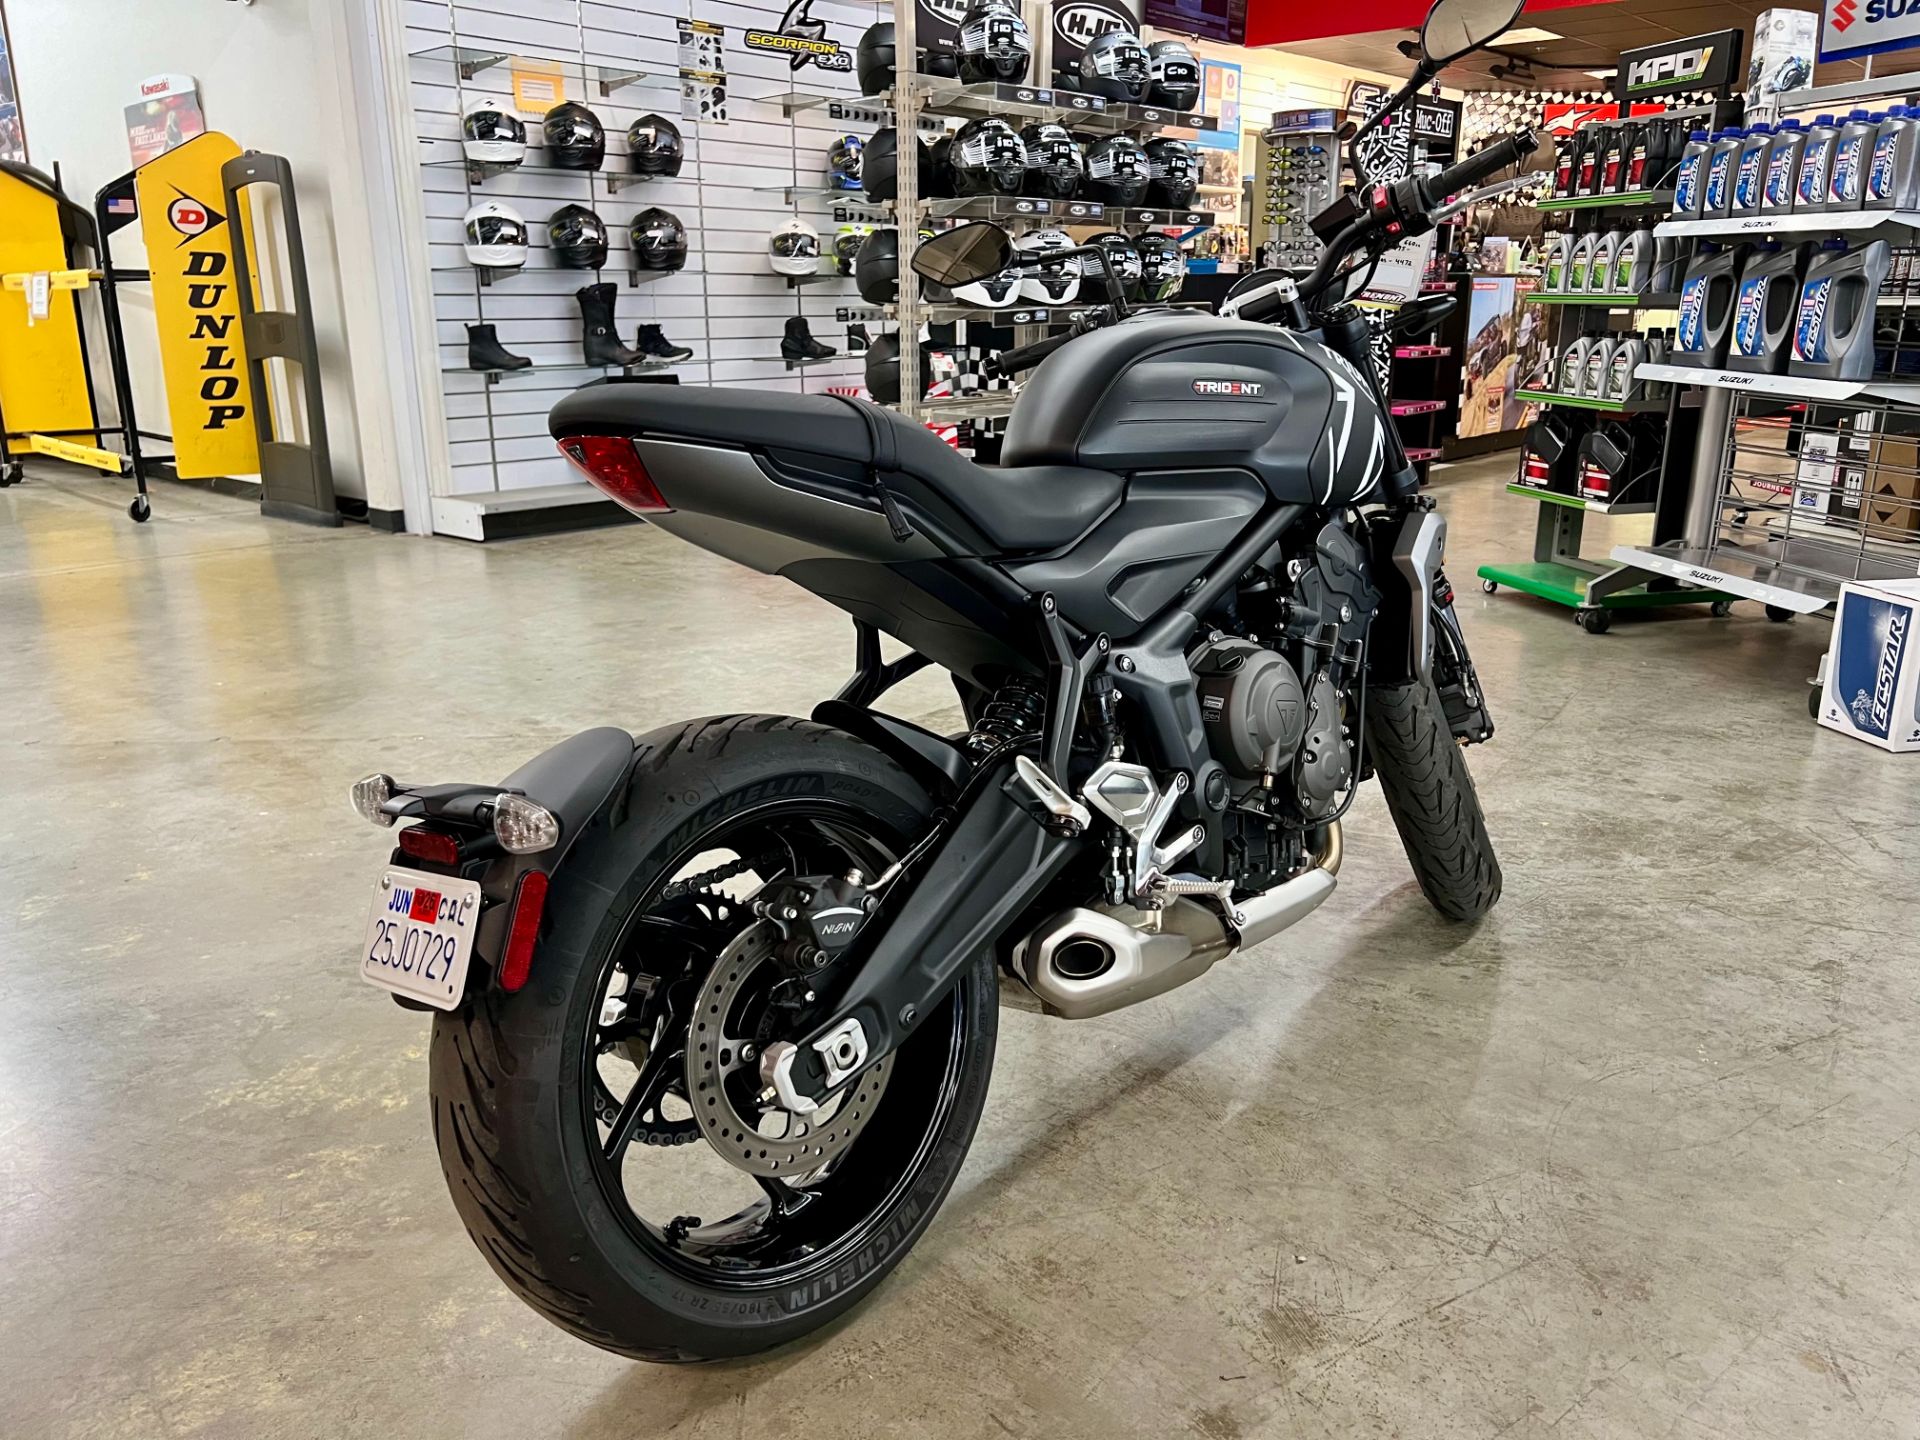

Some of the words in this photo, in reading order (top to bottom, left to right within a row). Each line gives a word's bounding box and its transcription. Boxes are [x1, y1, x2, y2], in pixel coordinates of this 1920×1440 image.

[747, 32, 838, 55] SCORPION
[1415, 110, 1452, 133] Muc-Off
[177, 209, 205, 225] D
[1742, 221, 1778, 229] SUZUKI
[1805, 278, 1832, 360] ECSTAR
[183, 251, 245, 430] DUNLOP
[1196, 381, 1262, 395] TRIDENT
[1718, 375, 1754, 385] SUZUKI
[1752, 480, 1785, 493] JOURNEY
[1689, 570, 1723, 583] SUZUKI
[1871, 610, 1908, 732] ECSTAR
[664, 774, 819, 853] MICHELIN
[389, 888, 413, 914] JUN
[438, 897, 465, 927] CAL
[369, 919, 456, 983] 25J0729
[789, 1197, 922, 1311] MICHELIN
